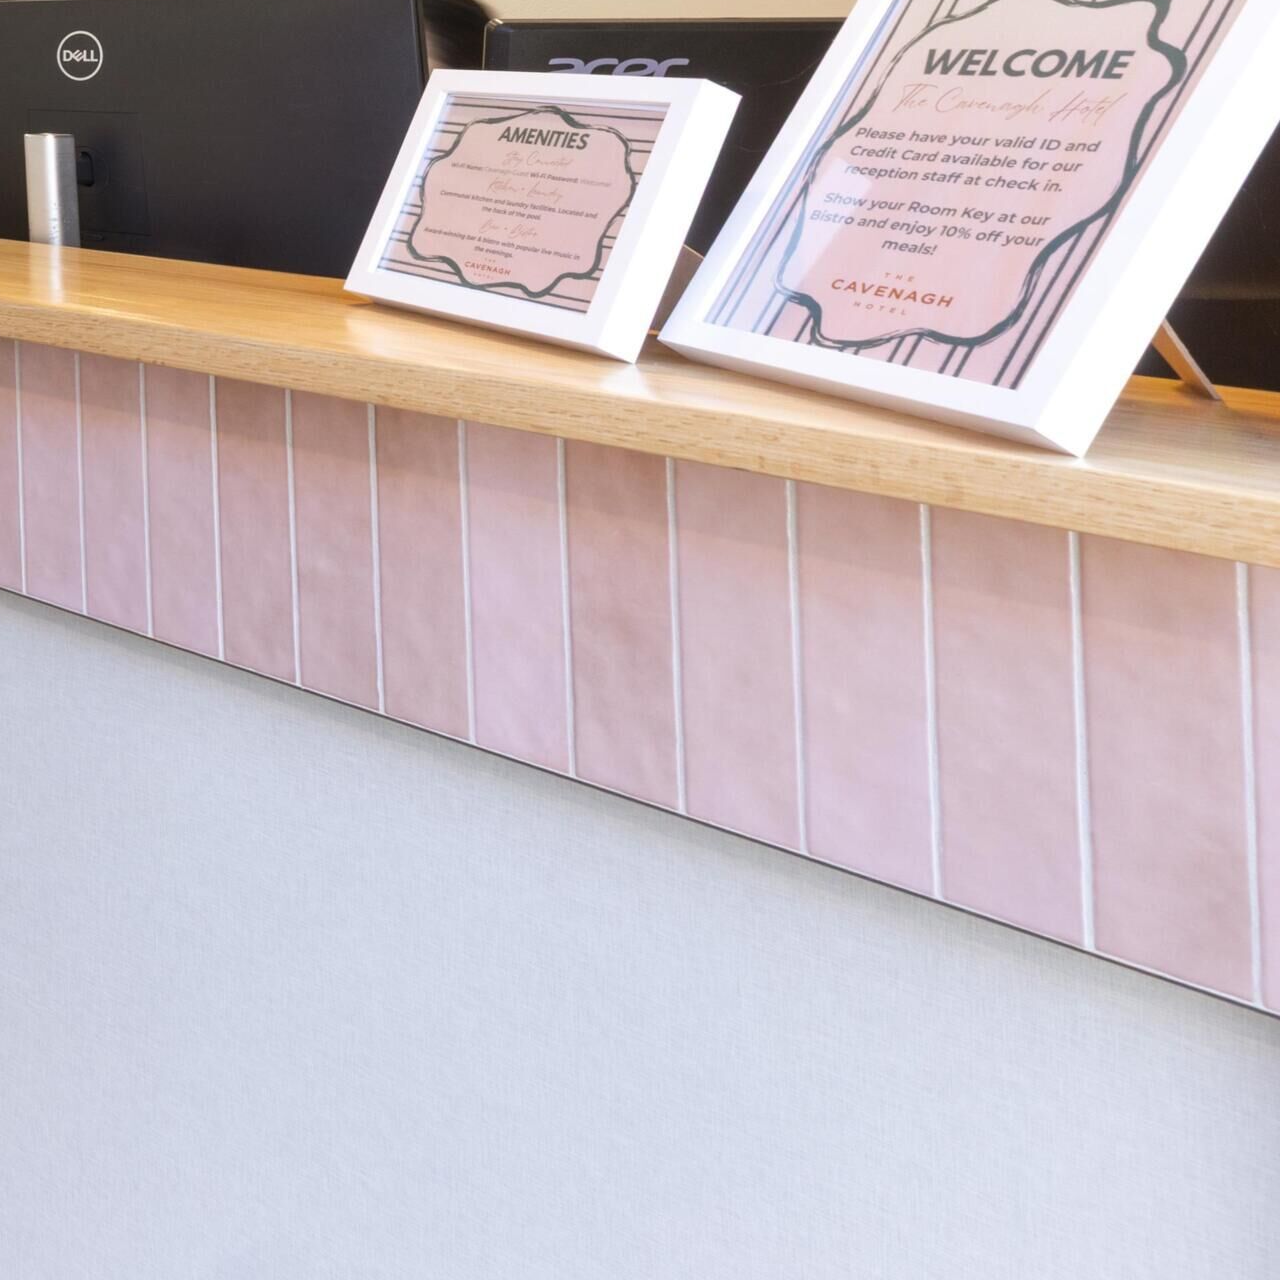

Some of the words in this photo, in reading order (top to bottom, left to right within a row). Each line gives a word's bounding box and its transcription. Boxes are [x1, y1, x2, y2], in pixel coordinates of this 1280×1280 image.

[62, 49, 99, 62] DELL
[548, 57, 689, 77] acer
[923, 48, 1136, 79] WELCOME
[893, 83, 938, 112] The
[935, 86, 1052, 120] Cavenagh
[1047, 90, 1129, 126] Hotel
[497, 125, 591, 151] AMENITIES
[855, 126, 906, 142] Please
[909, 130, 947, 144] have
[948, 133, 991, 147] your
[994, 135, 1036, 150] valid
[1040, 138, 1061, 151] ID
[1064, 140, 1102, 153] and
[849, 145, 897, 160] Credit
[900, 149, 939, 163] Card
[941, 153, 1018, 169] available
[1021, 157, 1048, 171] for
[1051, 161, 1083, 173] our
[844, 163, 919, 182] reception
[920, 170, 963, 185] staff
[963, 175, 982, 186] at
[984, 176, 1040, 192] check
[1042, 180, 1063, 193] in.
[440, 189, 470, 200] Communal
[471, 193, 493, 204] kitchen
[493, 197, 506, 206] and
[506, 199, 529, 210] laundry
[557, 206, 585, 218] Located
[584, 211, 598, 220] and
[481, 205, 493, 213] the
[493, 207, 508, 216] back
[508, 209, 516, 217] of
[515, 210, 526, 218] the
[823, 192, 866, 208] Show
[867, 198, 906, 212] your
[907, 201, 958, 218] Room
[960, 206, 994, 222] Key
[997, 211, 1017, 224] at
[1020, 214, 1052, 227] our
[809, 209, 854, 225] Bistro
[857, 216, 888, 229] and
[890, 220, 936, 237] enjoy
[940, 223, 972, 240] 10%
[975, 229, 1002, 243] off
[1002, 233, 1046, 248] your
[423, 226, 466, 240] Award-winning
[466, 234, 477, 242] bar
[482, 236, 500, 246] bistro
[501, 239, 515, 249] with
[515, 243, 541, 255] popular
[540, 246, 553, 256] live
[553, 250, 572, 259] music
[473, 245, 485, 253] the
[880, 238, 939, 256] meals!
[464, 260, 512, 276] CAVENAGH
[883, 271, 916, 283] THE
[830, 278, 955, 308] CAVENAGH
[852, 301, 908, 316] HOTEL
